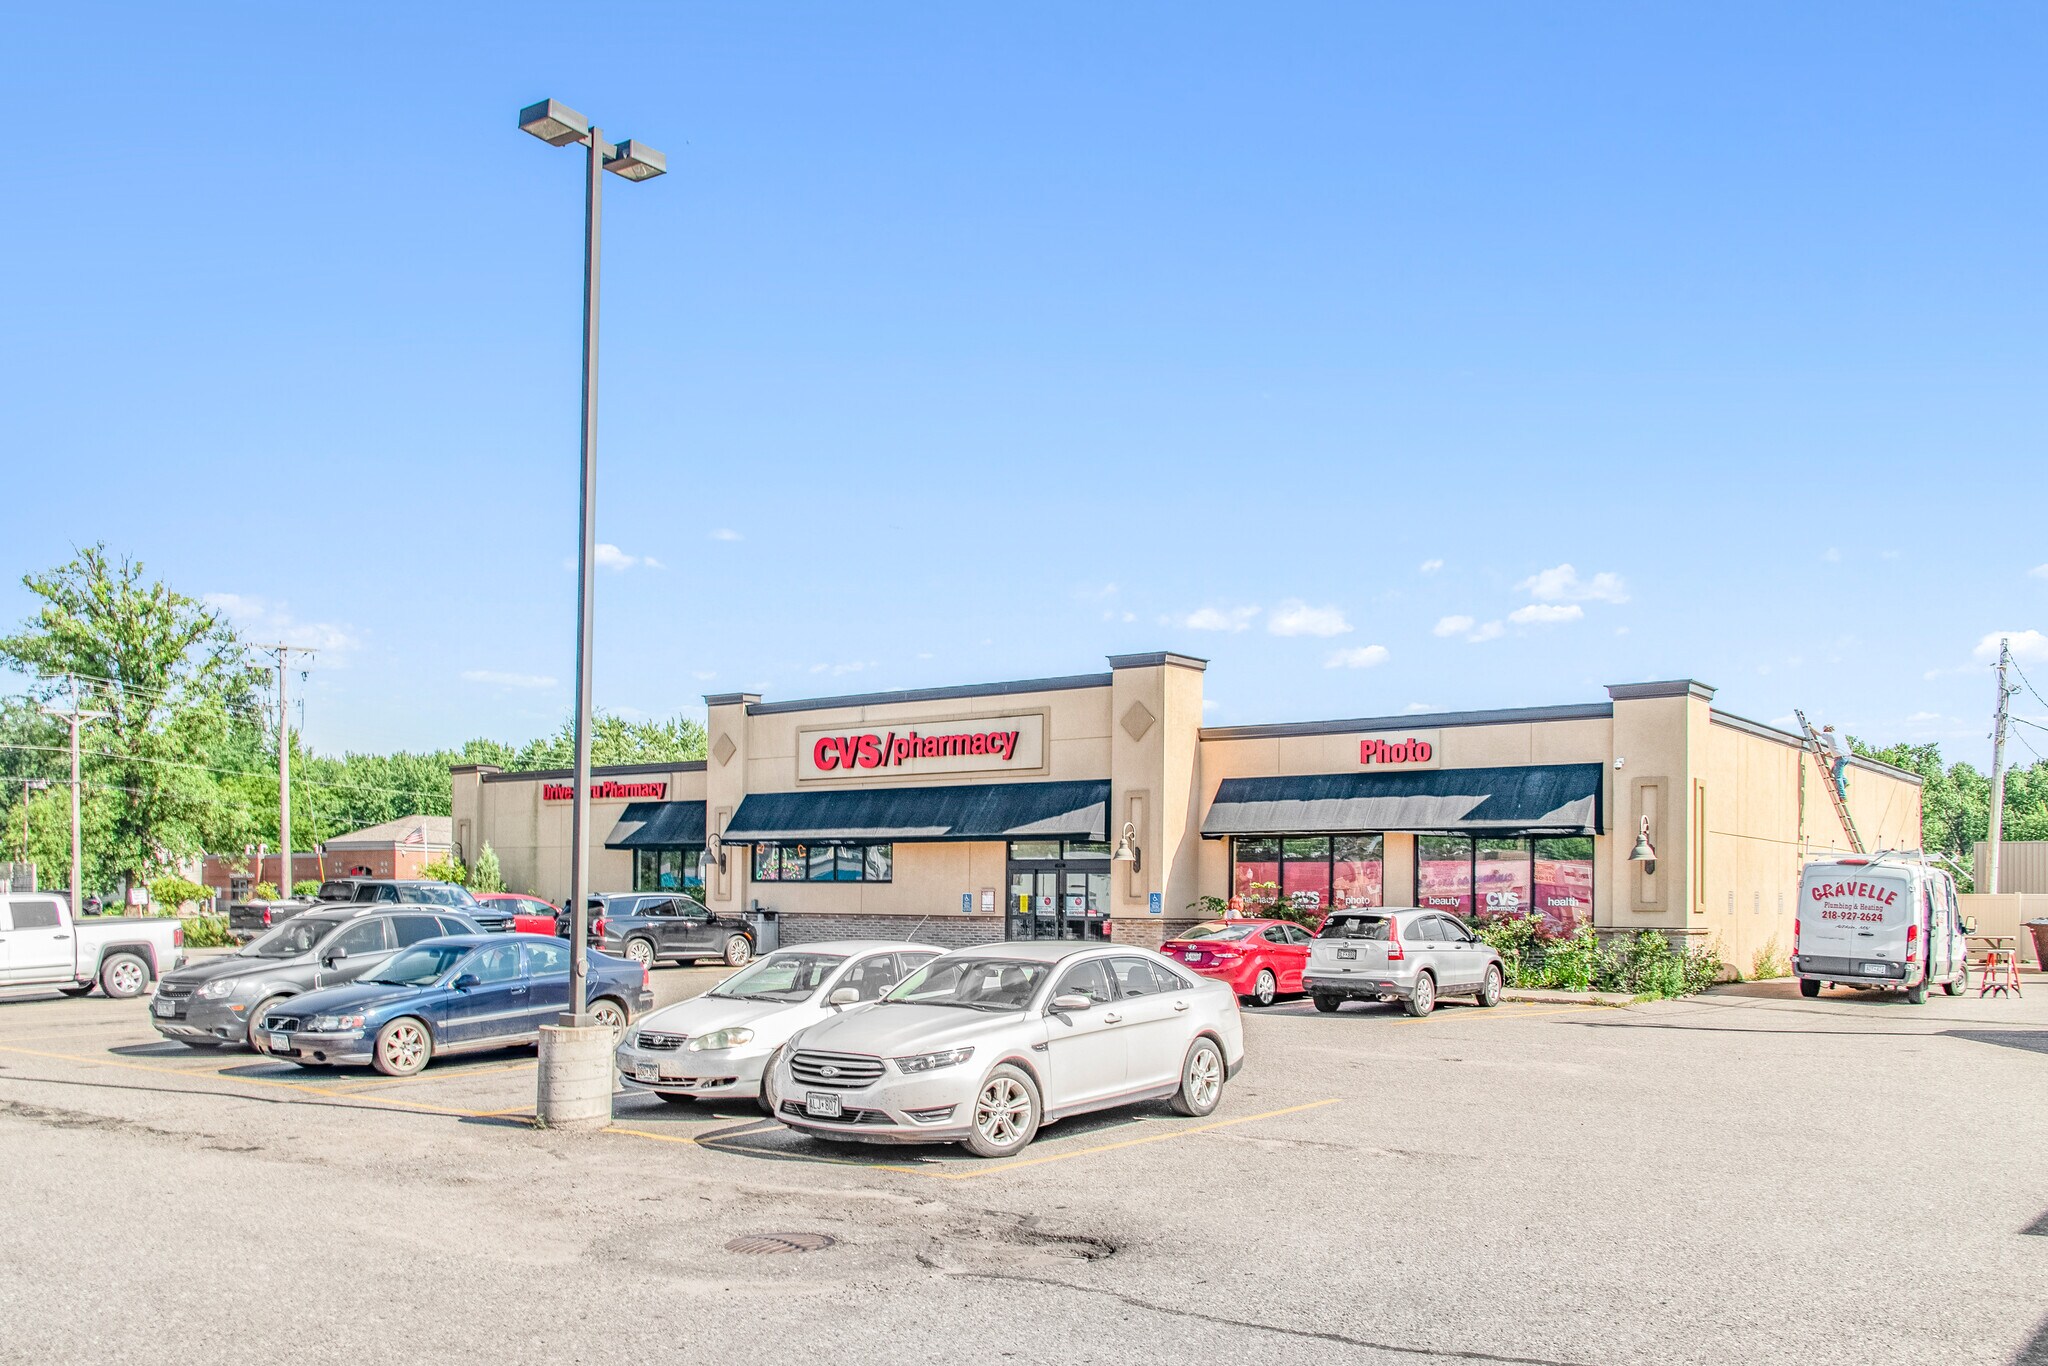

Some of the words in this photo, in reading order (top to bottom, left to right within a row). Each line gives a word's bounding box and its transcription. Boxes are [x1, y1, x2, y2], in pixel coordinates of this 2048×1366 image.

[813, 731, 1020, 771] CVS/pharmacy
[1360, 737, 1432, 764] Photo
[602, 781, 667, 800] Pharmacy
[1485, 891, 1519, 906] CVS
[1812, 881, 1898, 905] GRAVELLE
[1345, 896, 1370, 906] photo
[1428, 896, 1461, 907] beauty
[1547, 896, 1579, 907] health
[1824, 901, 1853, 911] Plumbing
[1860, 903, 1884, 912] Heating
[1821, 910, 1883, 922] 218-927-2624
